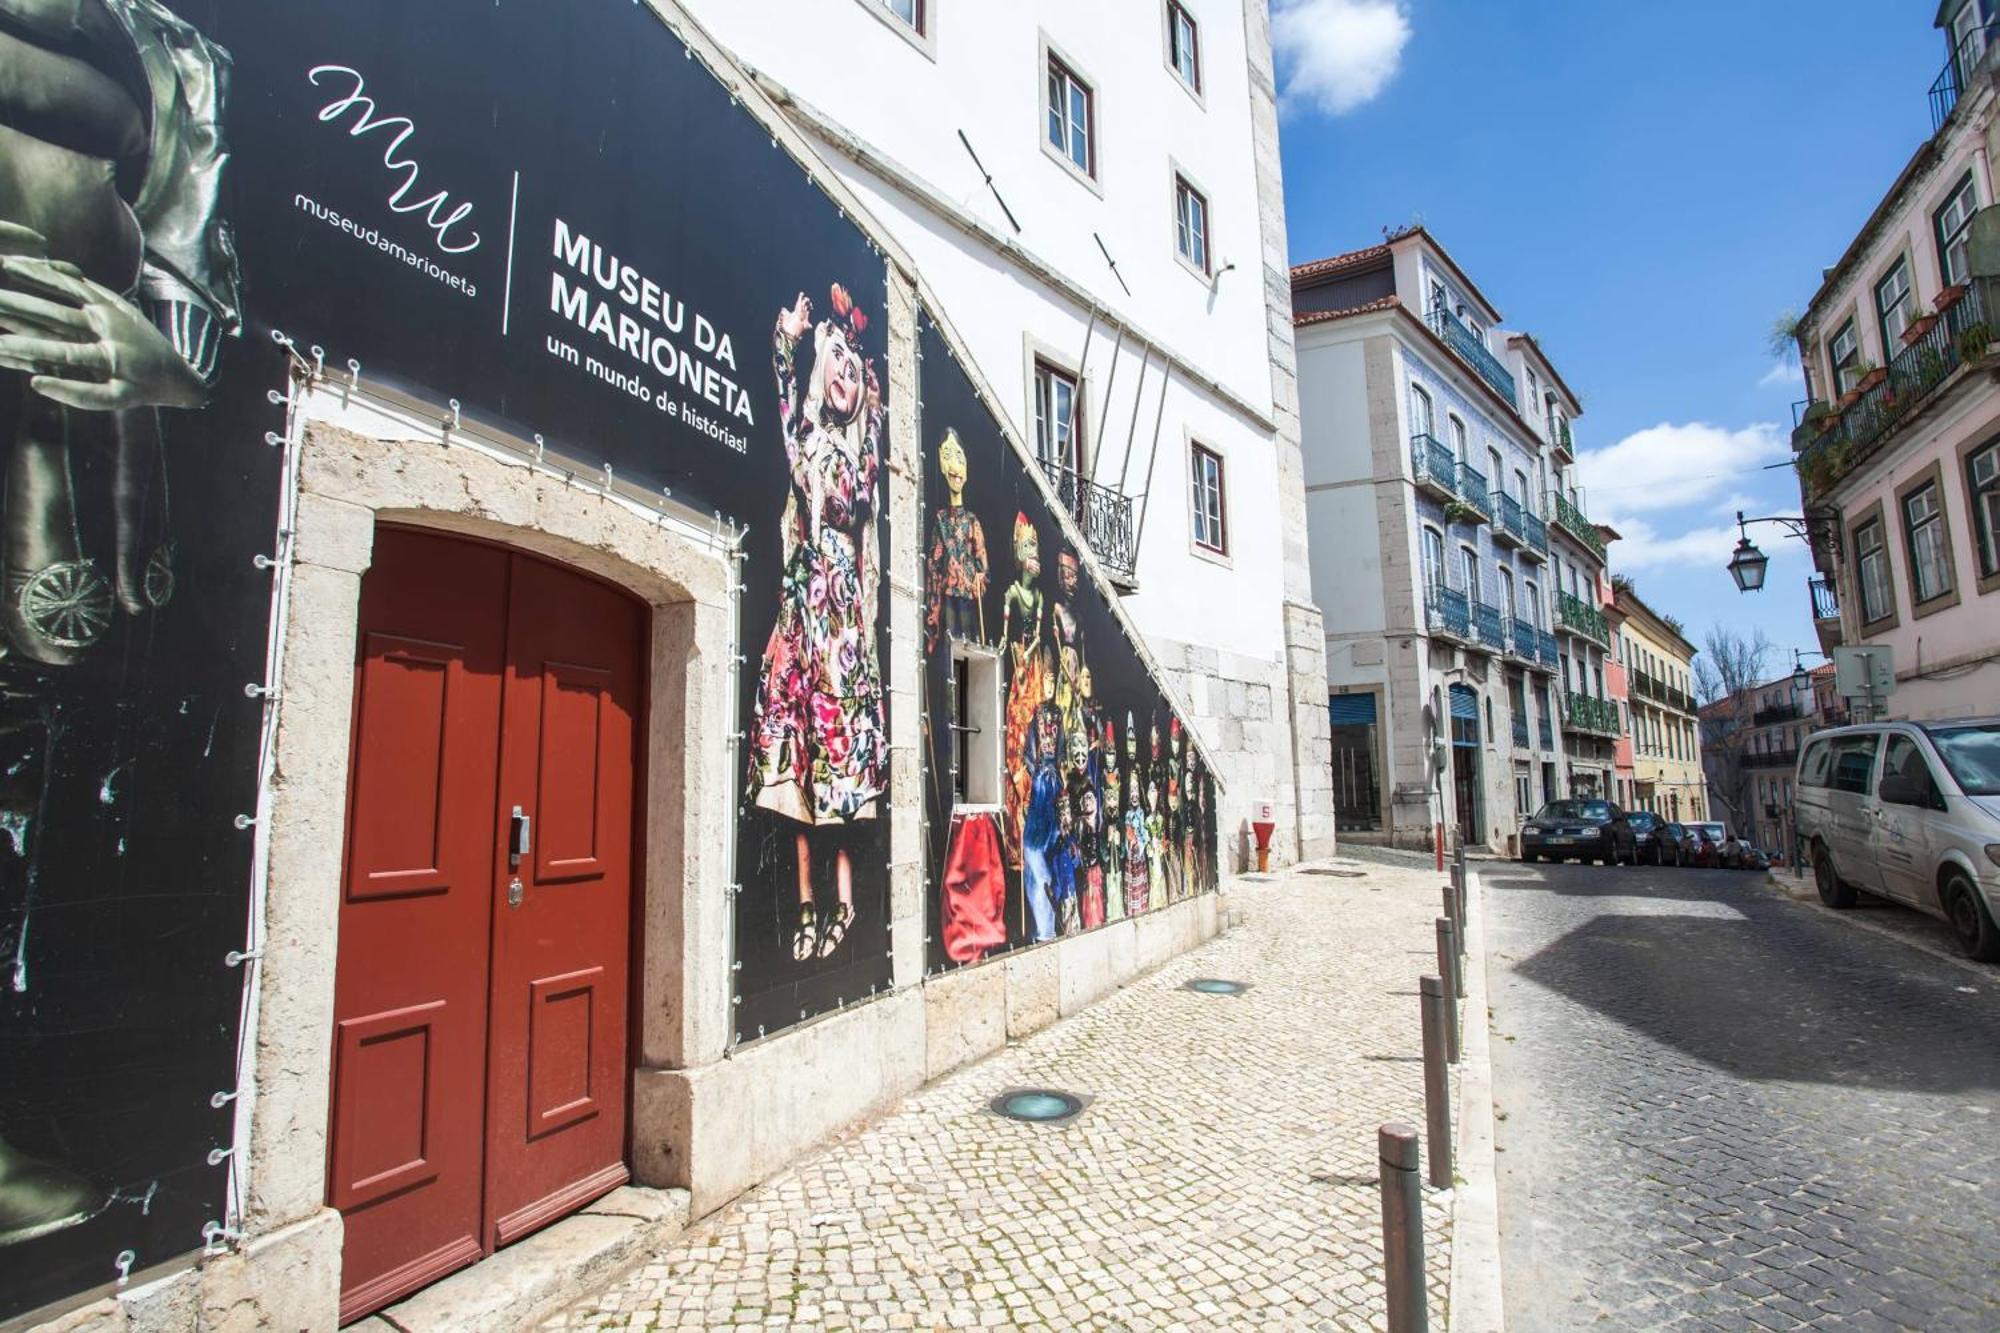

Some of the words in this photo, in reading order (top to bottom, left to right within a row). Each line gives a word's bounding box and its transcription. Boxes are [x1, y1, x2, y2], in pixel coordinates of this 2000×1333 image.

[294, 193, 478, 298] museudamarioneta
[553, 218, 685, 334] MUSEU
[694, 313, 737, 372] DA
[546, 335, 580, 367] um
[585, 356, 652, 403] mundo
[656, 390, 678, 418] de
[681, 401, 748, 456] histórias!
[550, 271, 755, 427] MARIONETA
